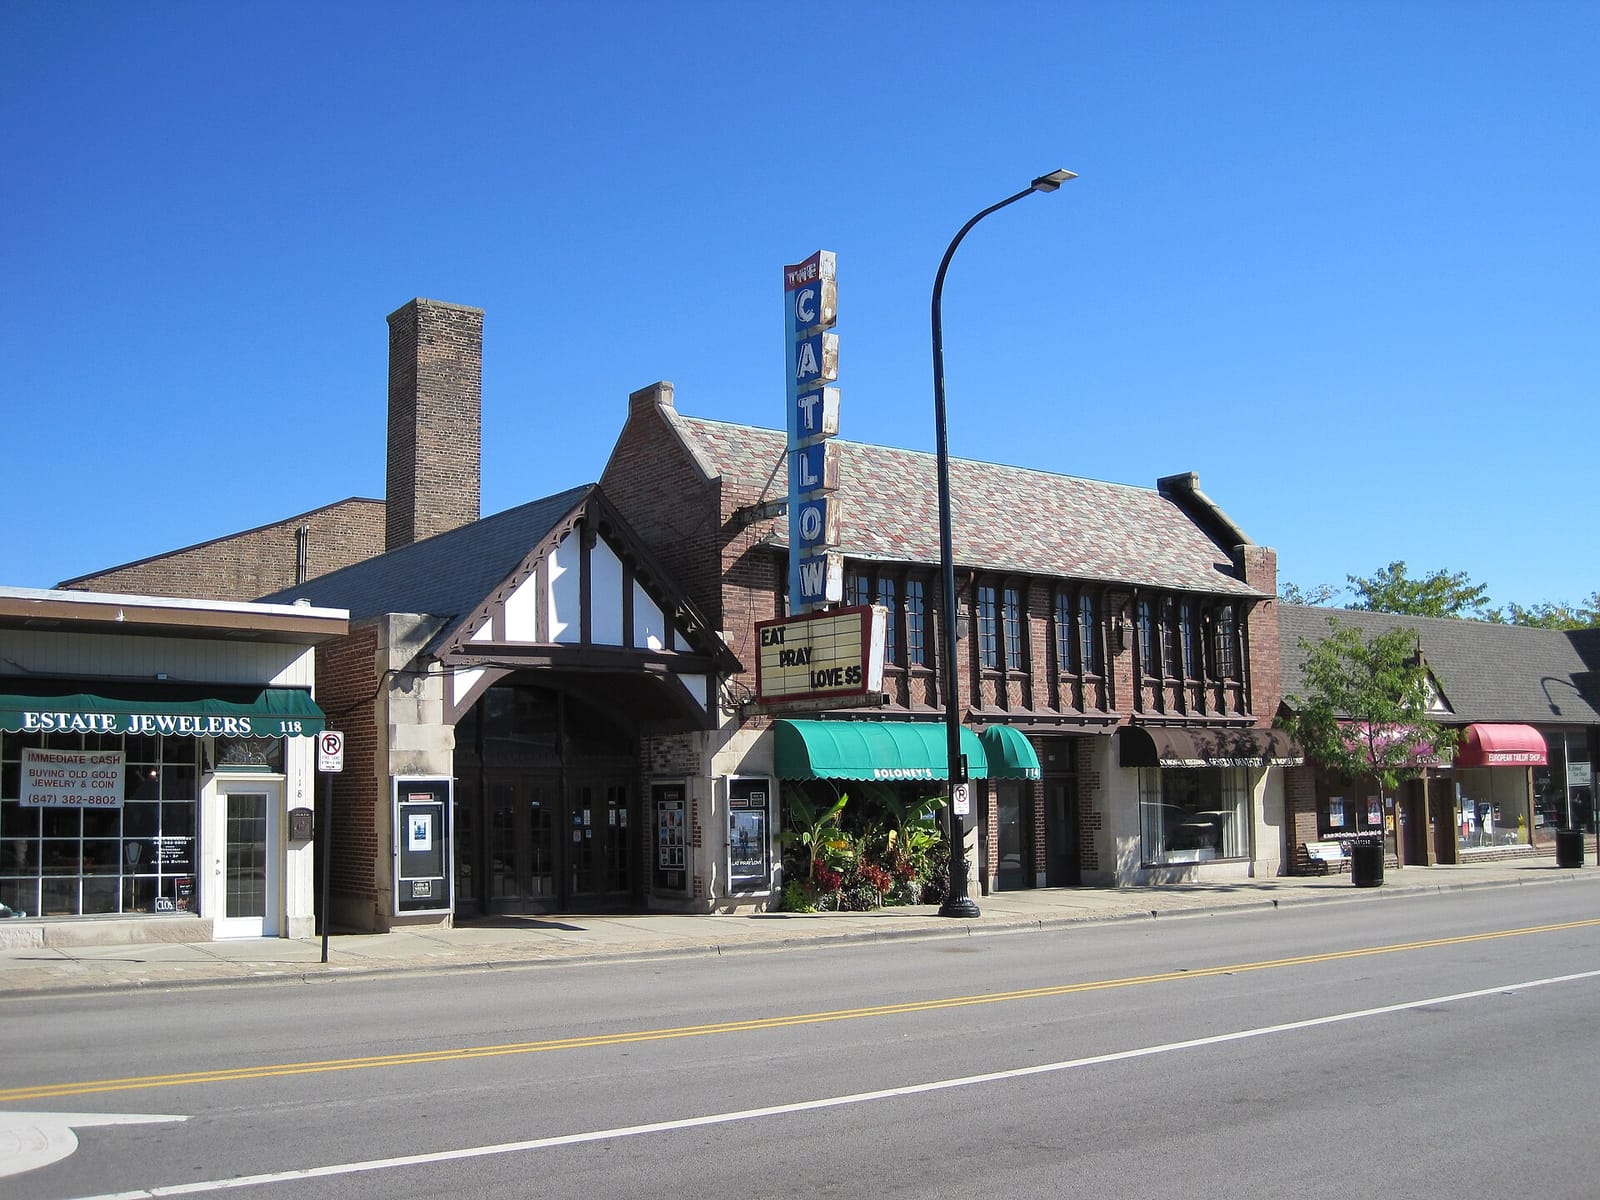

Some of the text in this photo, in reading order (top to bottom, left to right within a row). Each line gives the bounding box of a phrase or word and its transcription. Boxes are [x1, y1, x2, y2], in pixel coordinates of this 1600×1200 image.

[786, 263, 817, 288] THE
[795, 288, 826, 597] CATLOW
[761, 626, 786, 647] EAT
[779, 647, 812, 667] PRAY
[810, 666, 860, 688] LOVE $5
[23, 712, 302, 733] ESTATE JEWELERS 118
[28, 753, 120, 765] IMMEDIATE CASH
[1488, 753, 1512, 762] EUROPEAN
[1513, 753, 1528, 762] TAILOR
[29, 768, 118, 779] BUYING OLD GOLD
[873, 768, 932, 778] BOLONEY'S
[32, 779, 77, 788] JEWELRY
[91, 780, 114, 788] COIN
[28, 794, 116, 805] (847) 382-8802
[157, 900, 176, 910] CLOS
